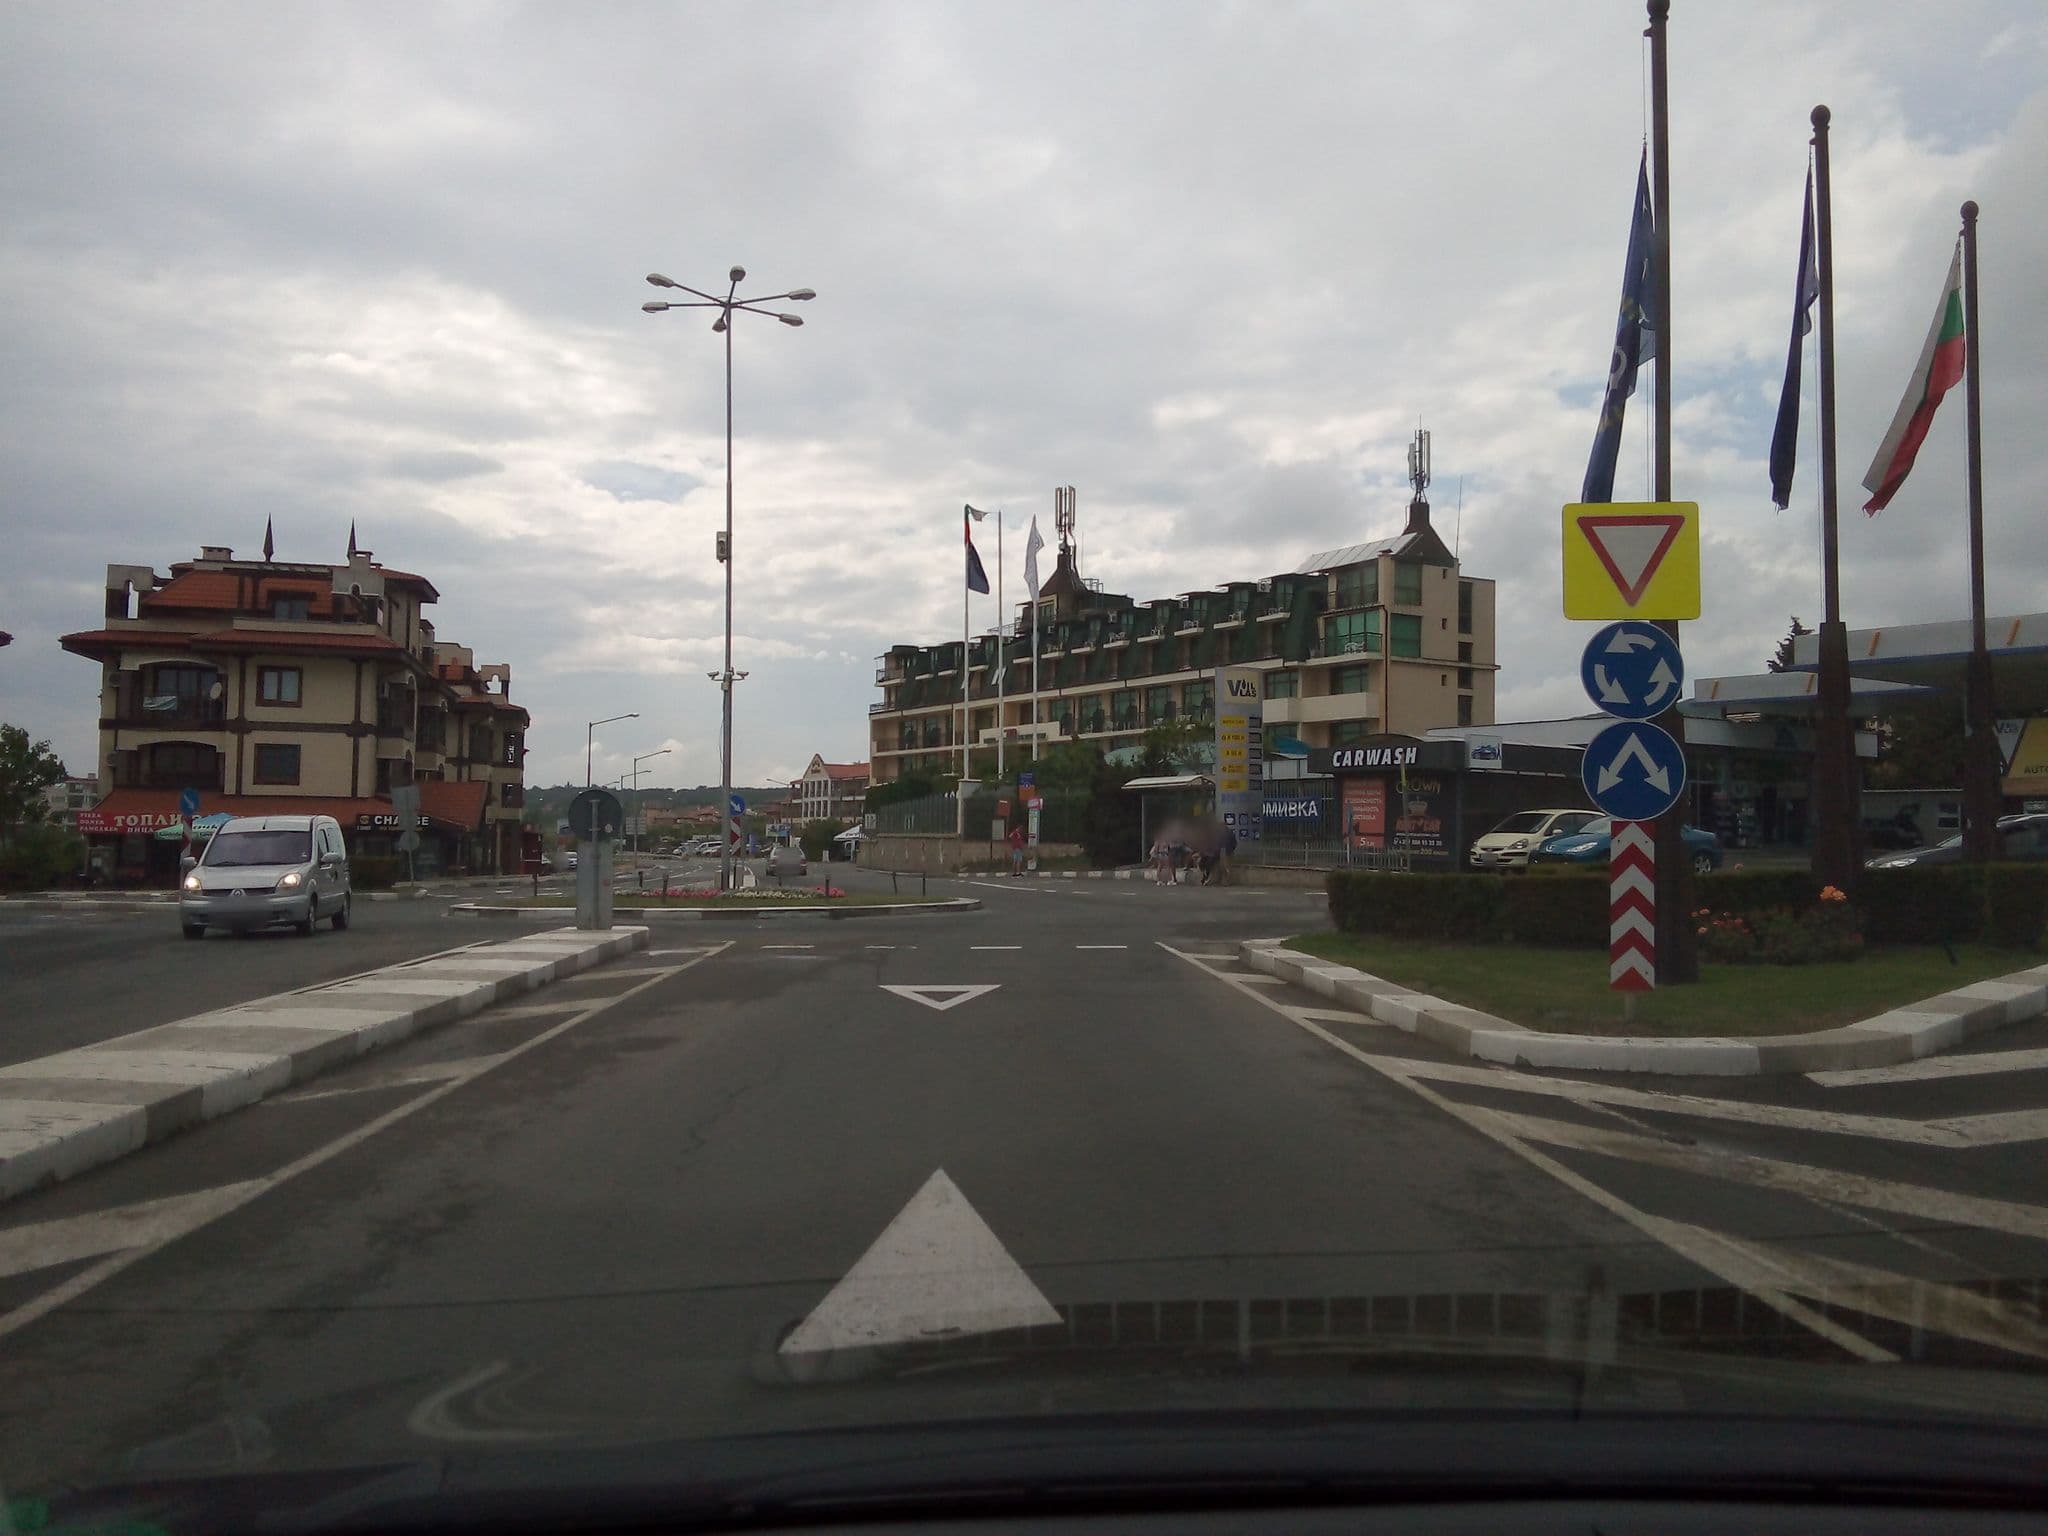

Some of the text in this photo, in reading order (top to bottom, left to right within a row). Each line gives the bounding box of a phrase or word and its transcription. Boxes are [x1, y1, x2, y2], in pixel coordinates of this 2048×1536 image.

[1332, 747, 1417, 767] CARWASH
[114, 814, 183, 827] ТОПЛИ
[374, 815, 430, 826] CHAE
